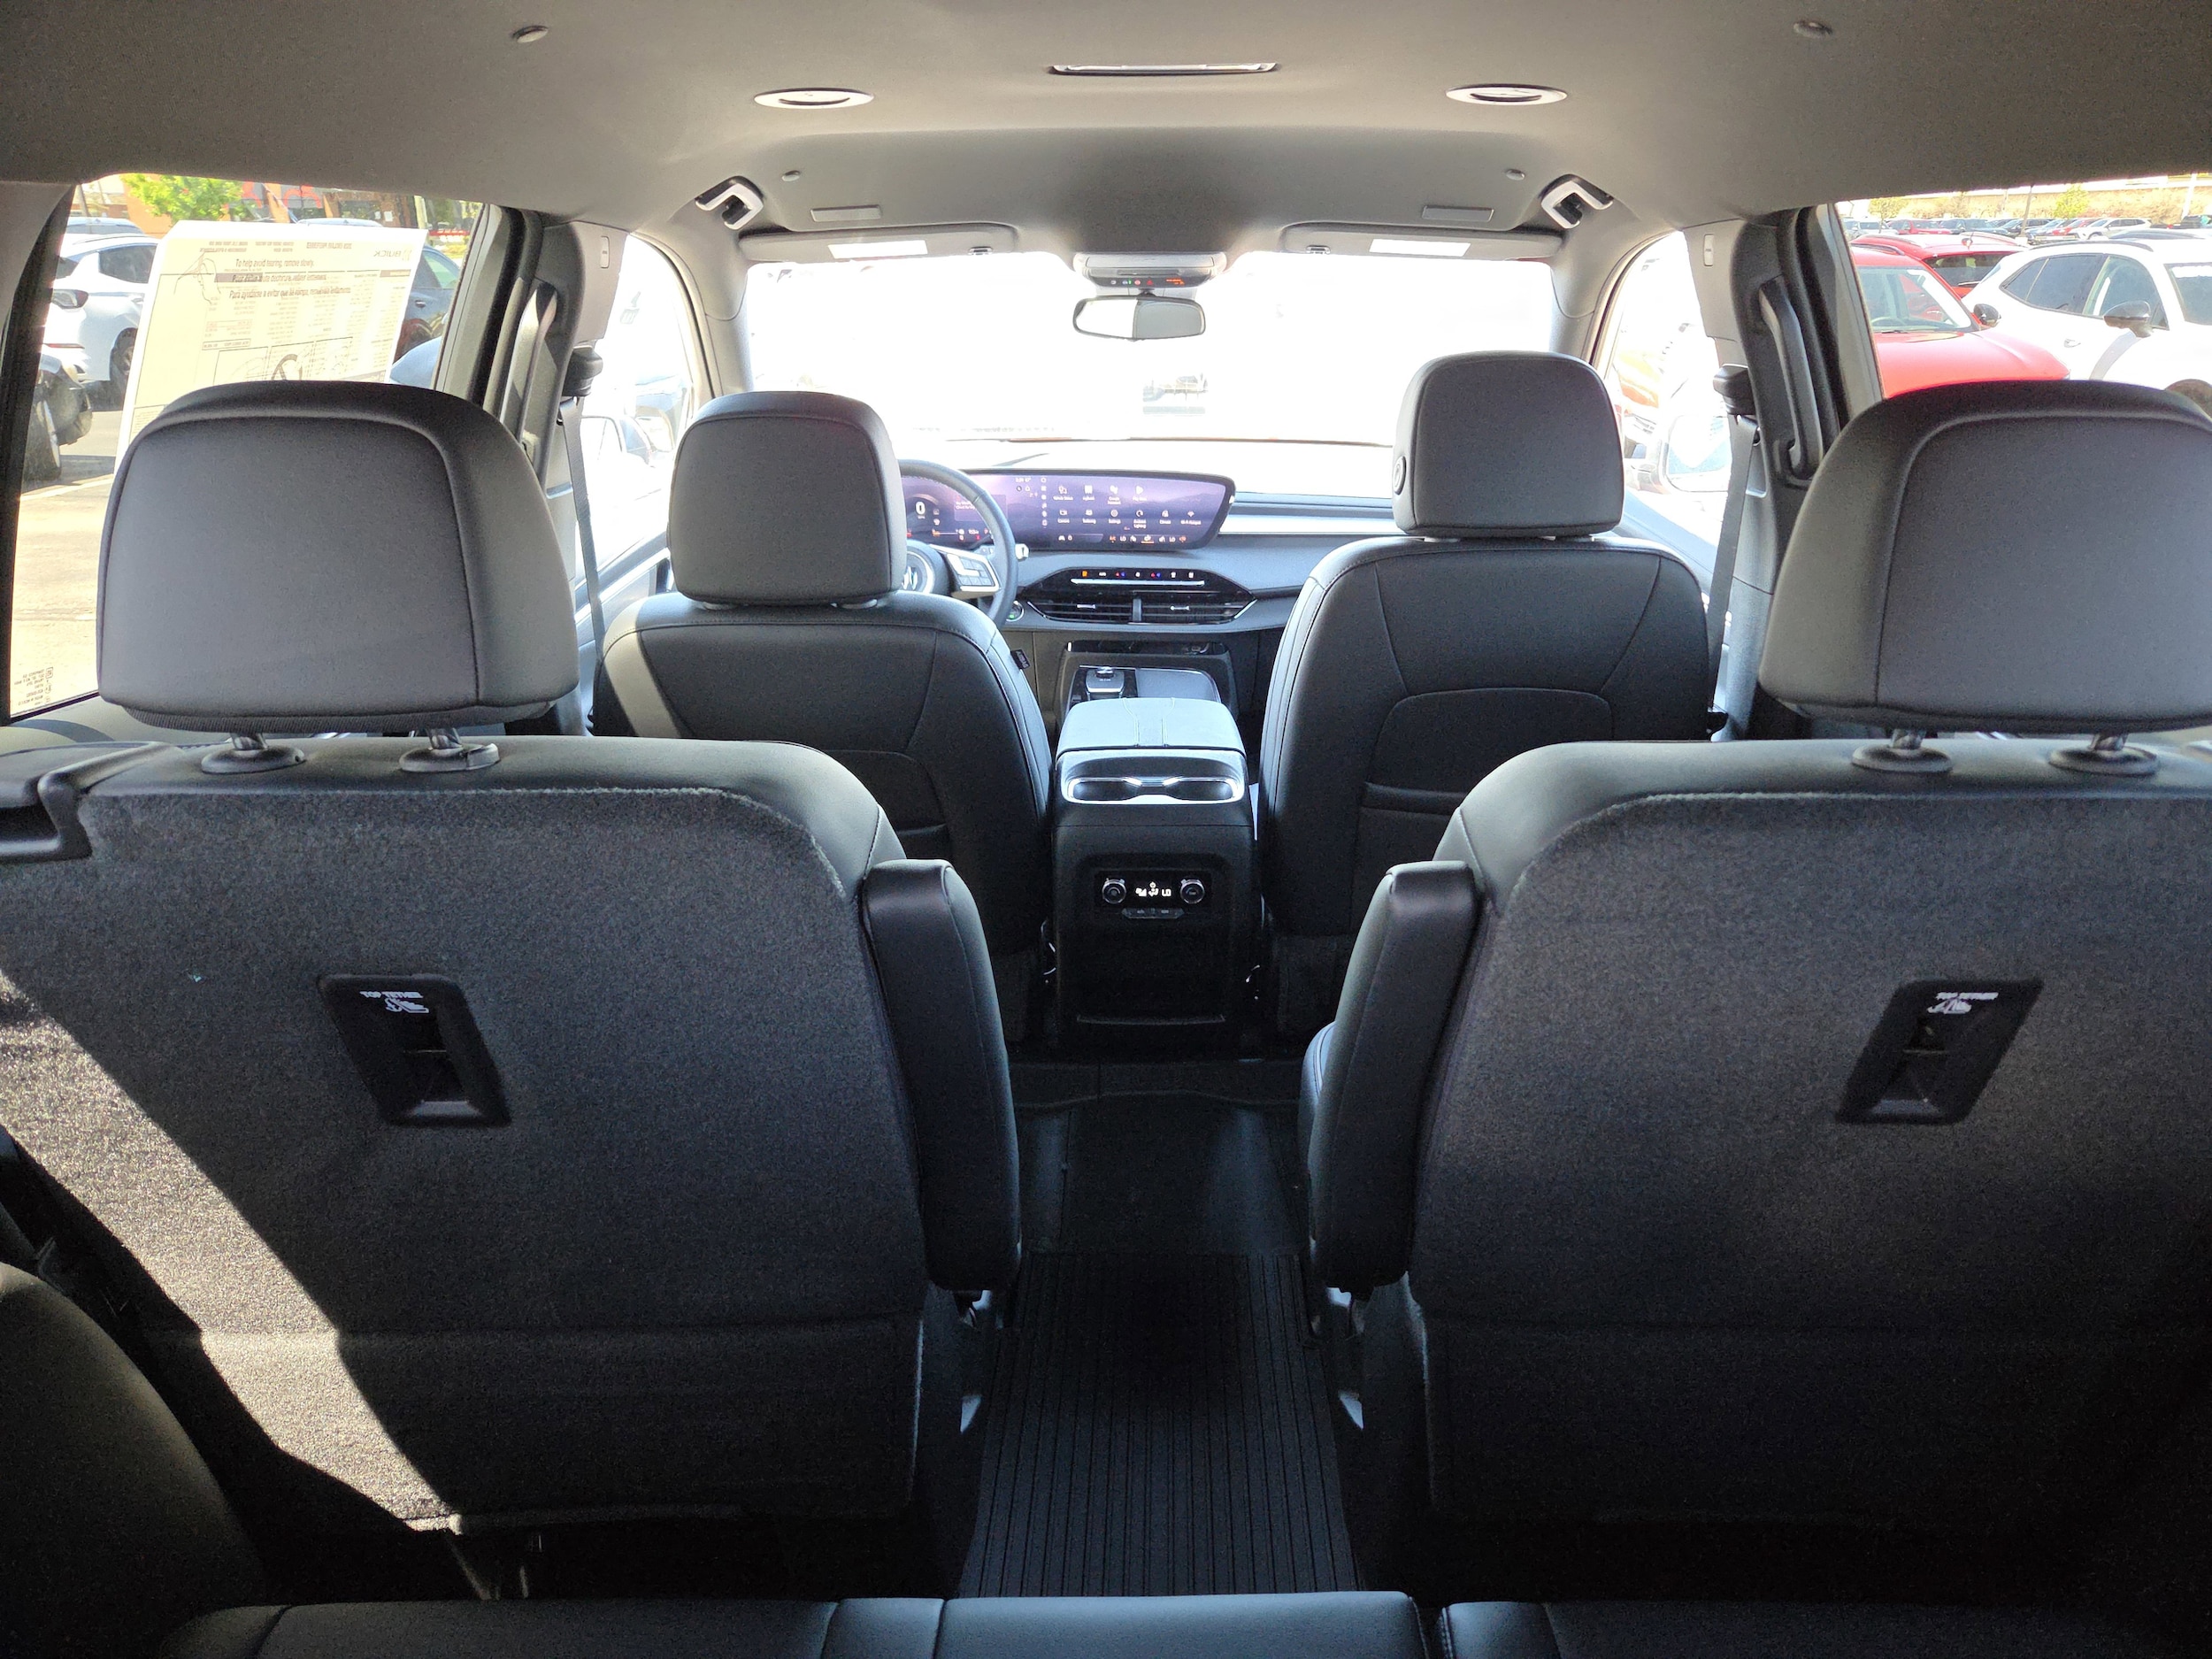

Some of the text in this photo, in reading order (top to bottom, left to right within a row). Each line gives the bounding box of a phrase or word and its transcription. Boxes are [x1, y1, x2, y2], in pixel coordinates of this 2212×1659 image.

[235, 258, 242, 267] To
[242, 258, 253, 269] help
[253, 258, 265, 267] avoid
